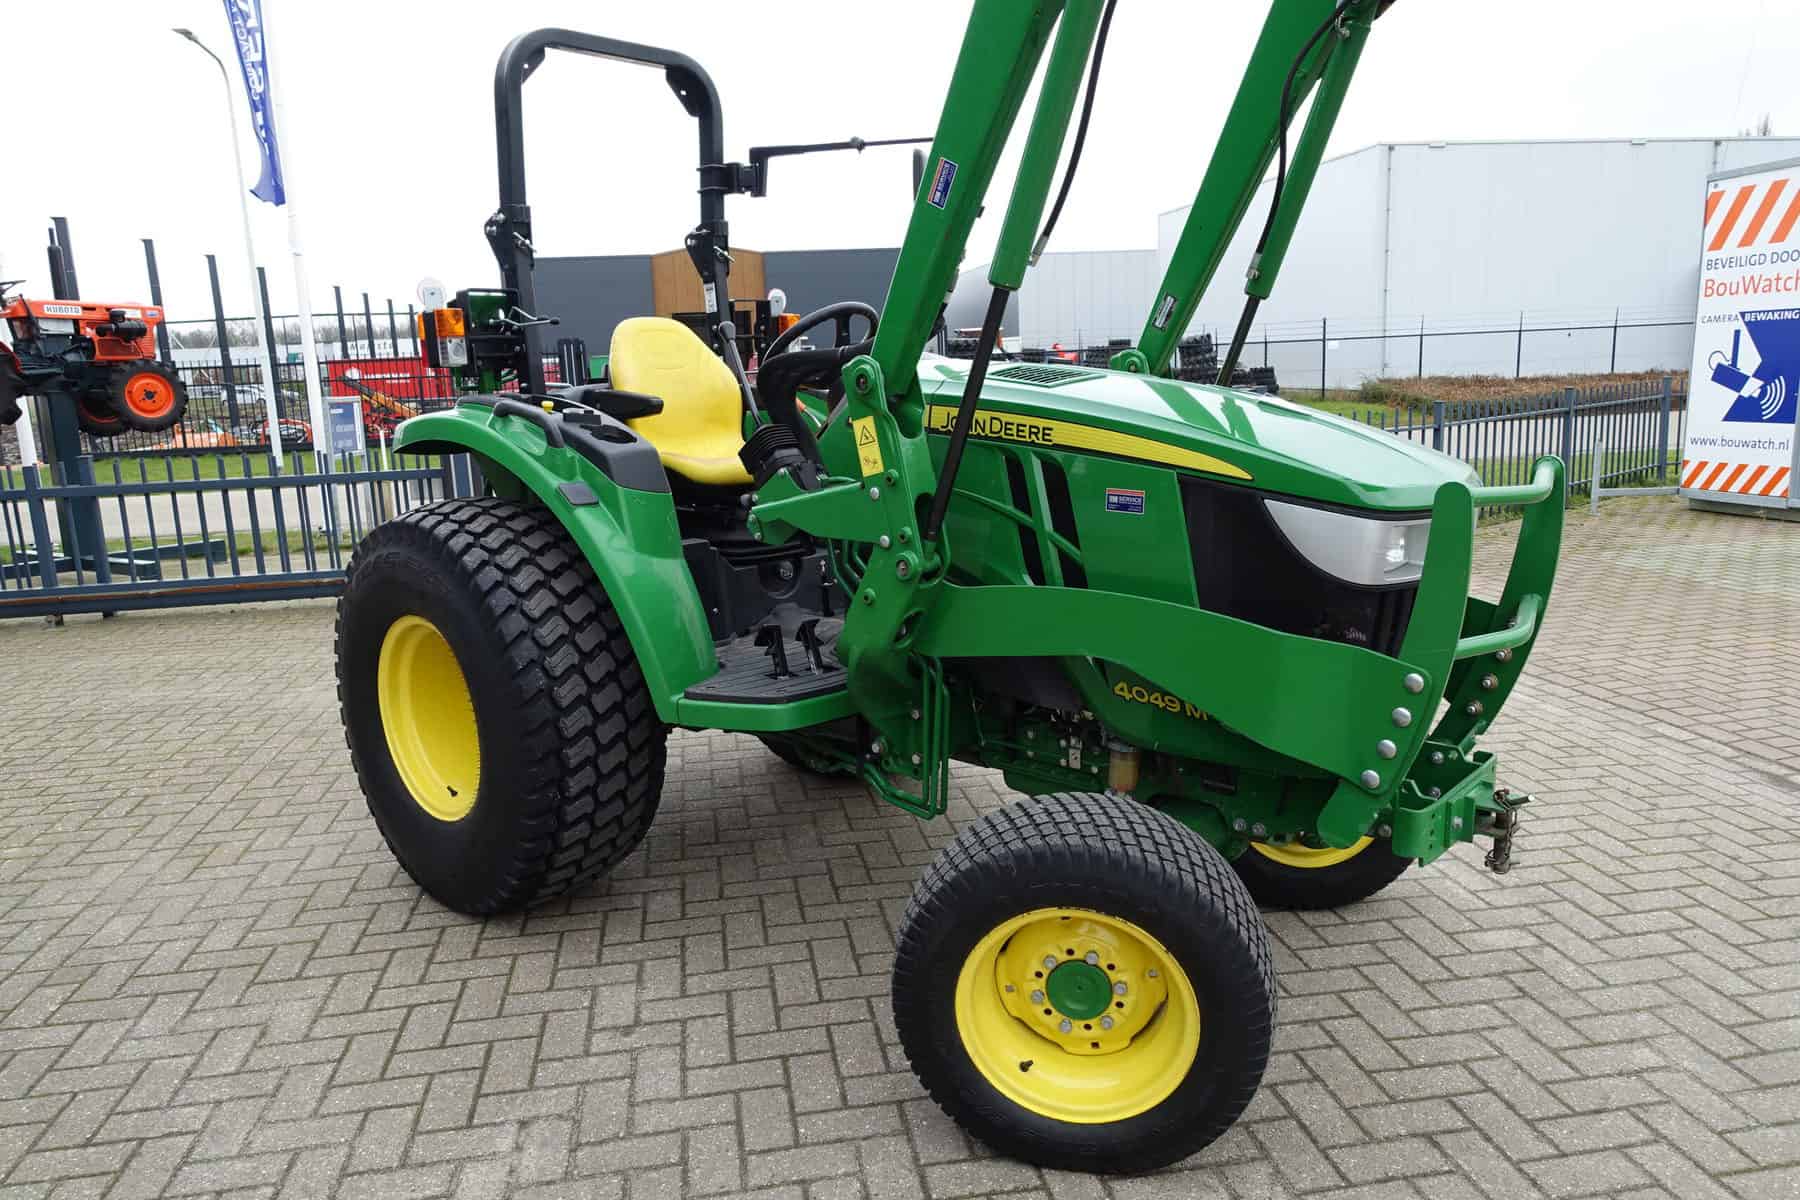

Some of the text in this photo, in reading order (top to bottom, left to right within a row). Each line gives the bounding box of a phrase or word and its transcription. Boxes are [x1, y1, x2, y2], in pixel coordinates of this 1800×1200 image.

[1706, 253, 1767, 271] BEVEILIGD
[1701, 309, 1800, 324] CAMERA BEWAKING
[940, 411, 1055, 442] JN DEERE
[1690, 436, 1790, 450] www.bouwatch.nl
